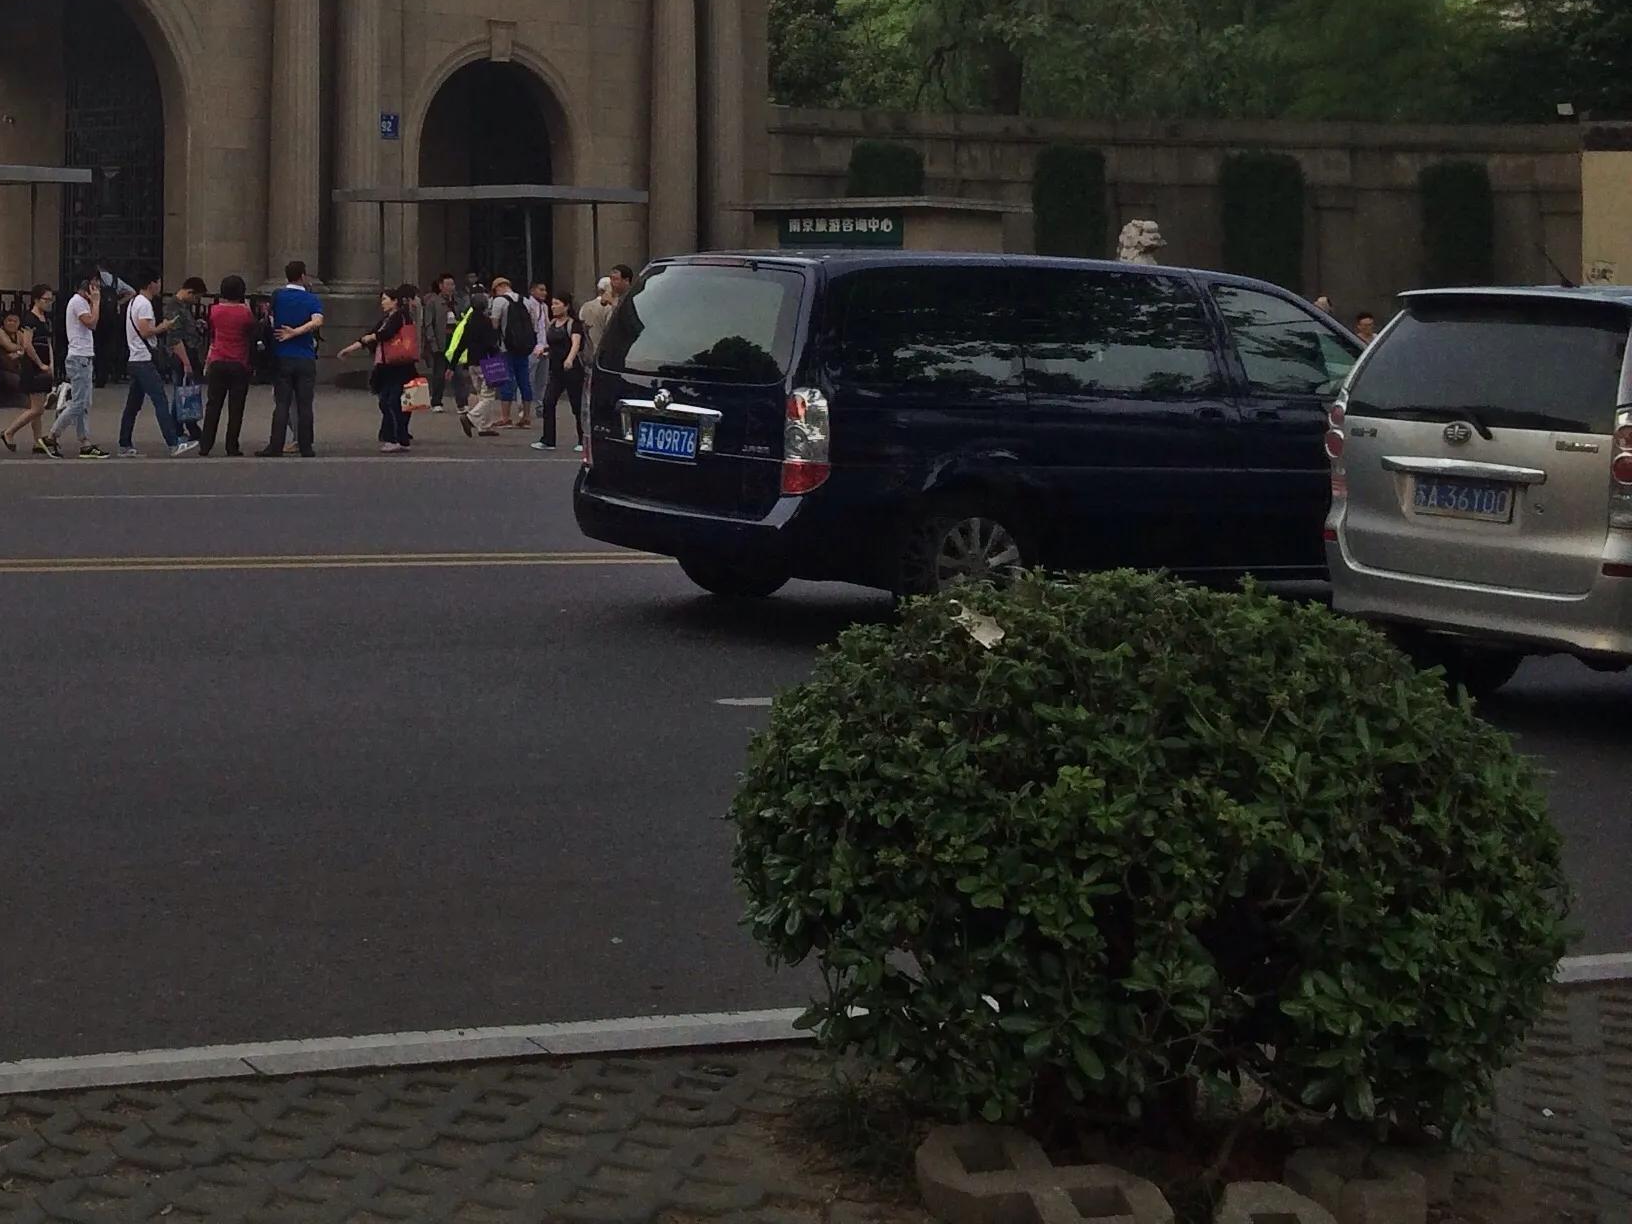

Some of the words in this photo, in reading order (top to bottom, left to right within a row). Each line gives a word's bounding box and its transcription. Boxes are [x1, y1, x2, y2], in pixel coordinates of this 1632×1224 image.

[381, 120, 393, 132] 92
[789, 217, 893, 233] 南京旅游咨询中心
